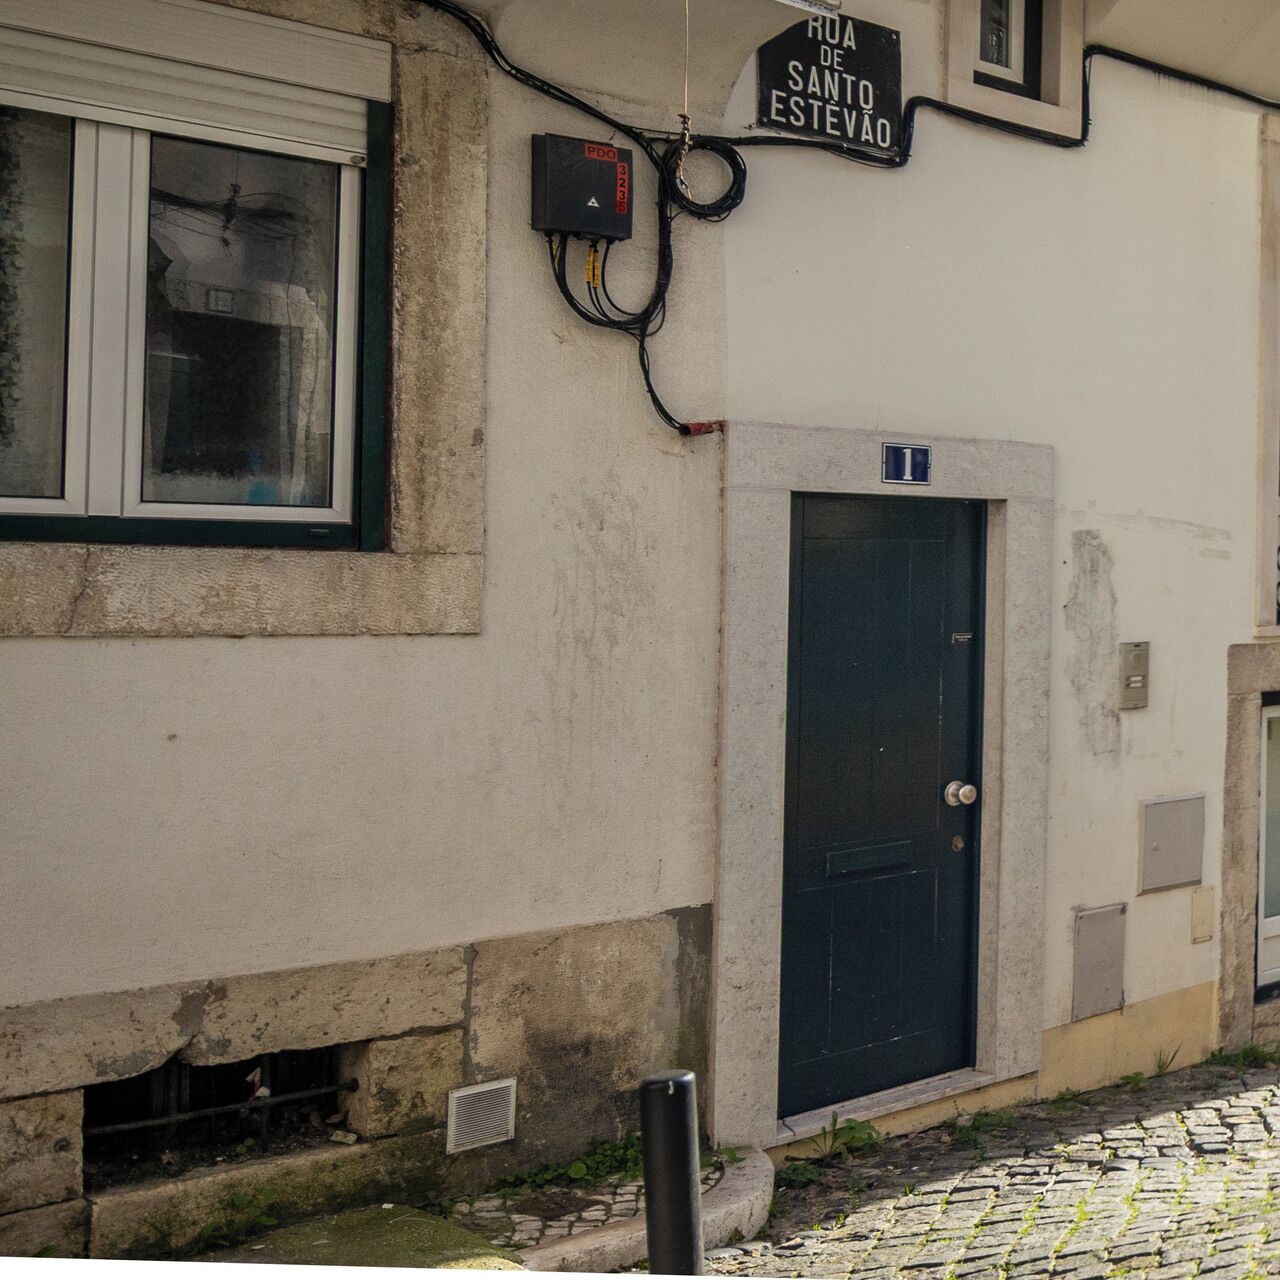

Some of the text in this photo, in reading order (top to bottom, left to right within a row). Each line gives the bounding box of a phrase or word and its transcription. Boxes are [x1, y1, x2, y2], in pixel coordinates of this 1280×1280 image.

[808, 16, 856, 50] RUA
[820, 45, 844, 70] DE
[788, 60, 873, 110] SANTO
[770, 89, 891, 148] ESTÊVÃO
[587, 146, 616, 159] PDO
[903, 448, 912, 480] 1
